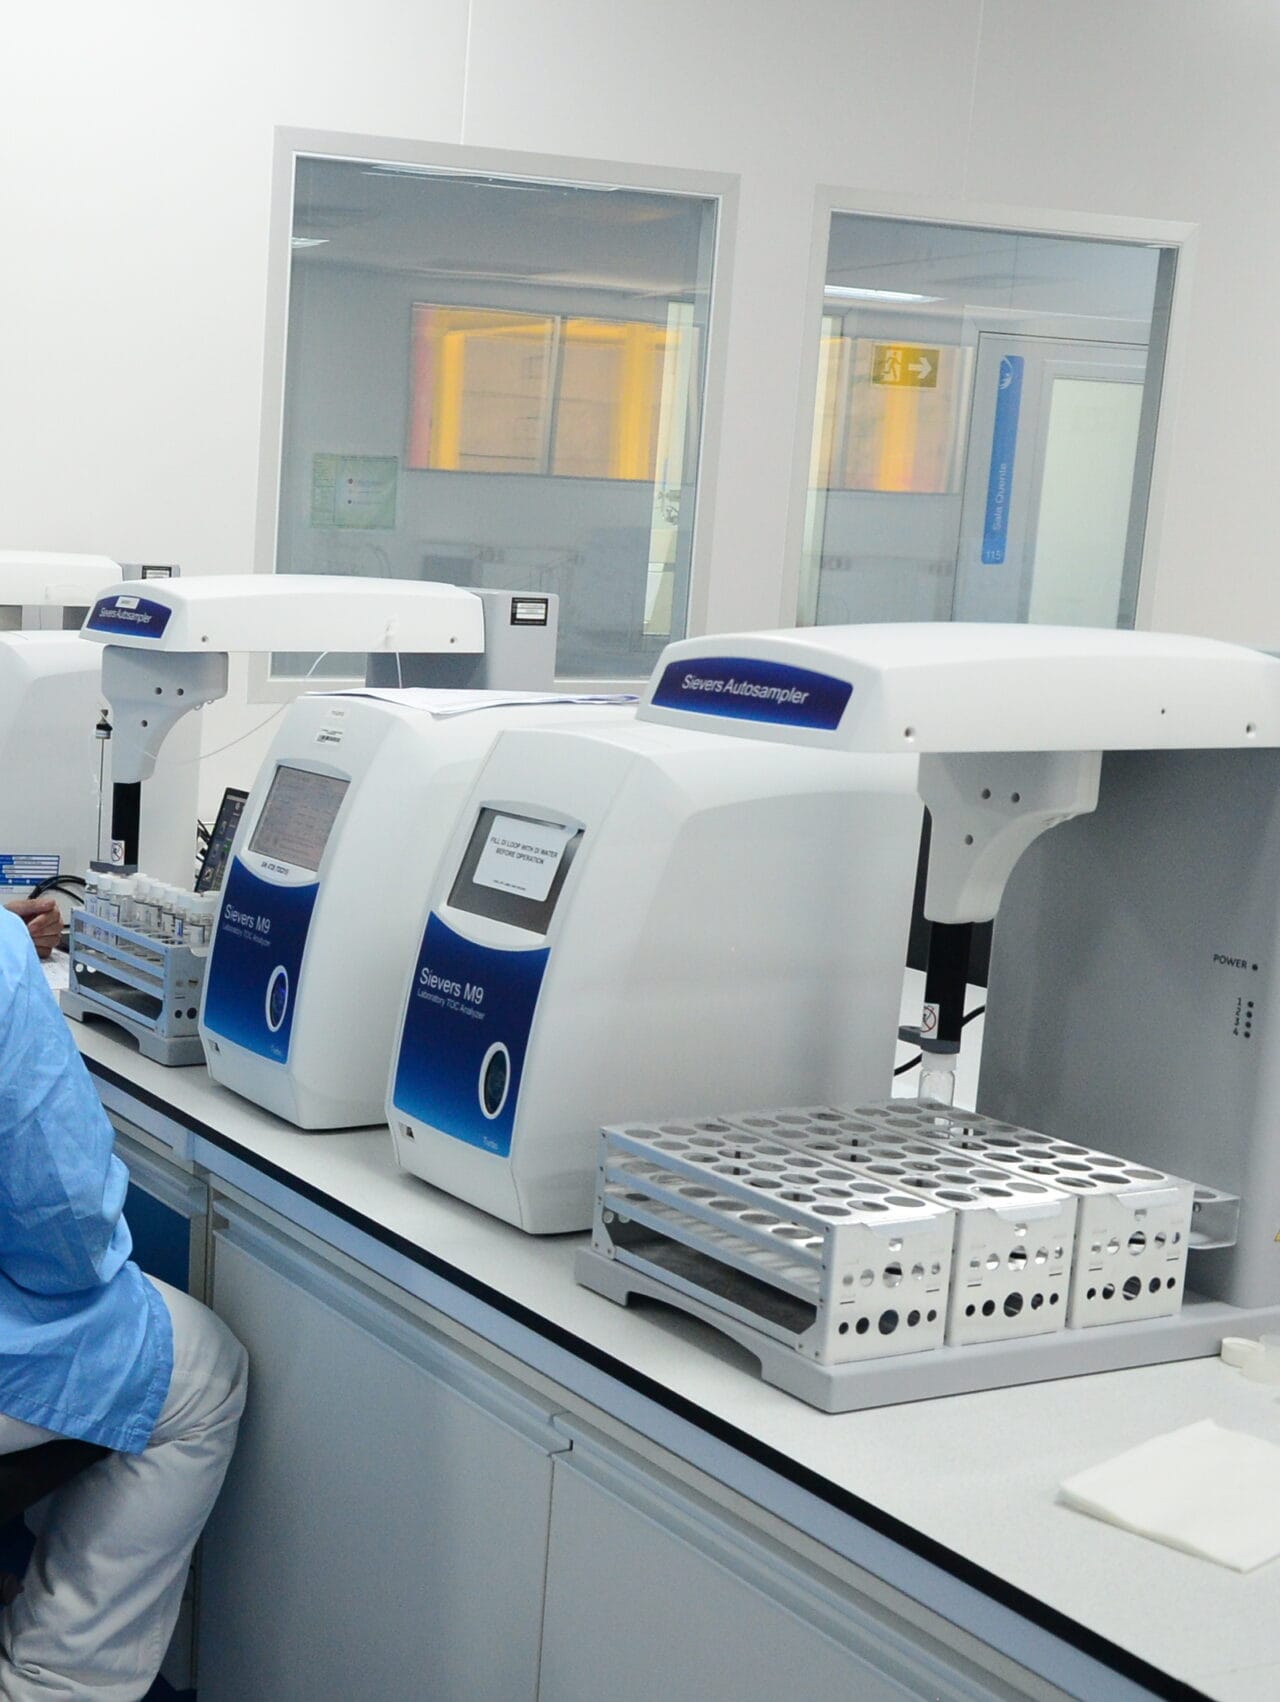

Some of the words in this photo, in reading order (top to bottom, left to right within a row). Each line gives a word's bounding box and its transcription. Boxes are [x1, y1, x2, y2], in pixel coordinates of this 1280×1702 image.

[681, 673, 724, 693] Sievers
[723, 678, 810, 704] Autosampler
[516, 853, 544, 865] OPERATION
[224, 903, 254, 928] Sievers
[255, 915, 271, 935] M9
[1213, 954, 1247, 969] POWER
[420, 967, 462, 997] Sievers
[463, 982, 484, 1006] M9
[417, 988, 445, 1006] Laboratory
[446, 998, 460, 1010] TOC
[460, 1004, 485, 1020] Analyzer
